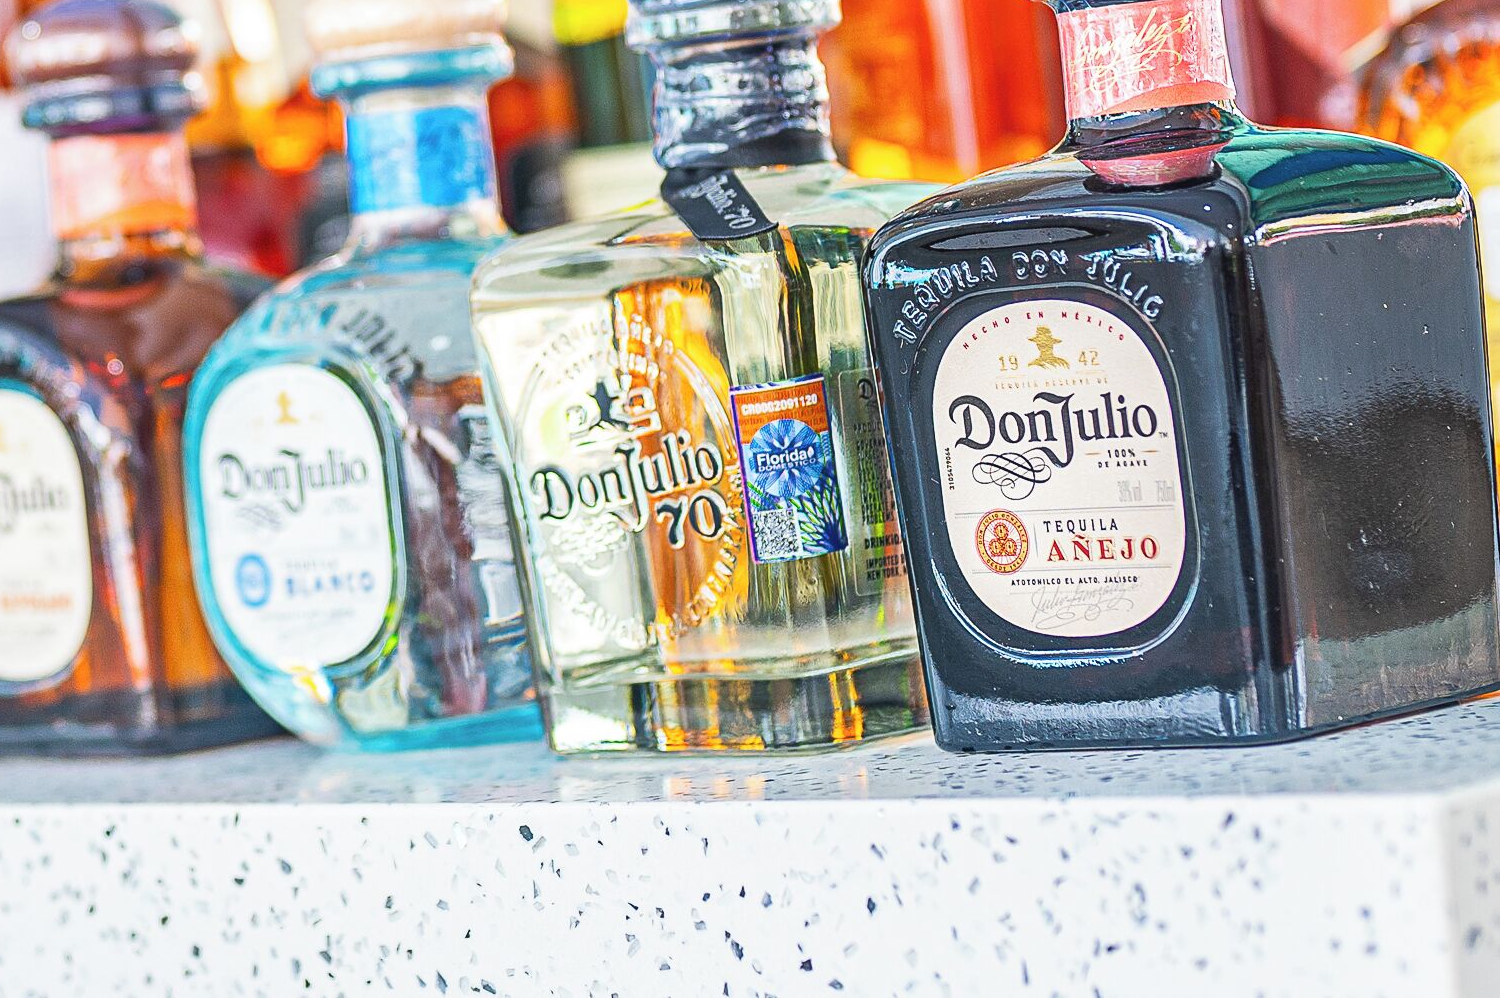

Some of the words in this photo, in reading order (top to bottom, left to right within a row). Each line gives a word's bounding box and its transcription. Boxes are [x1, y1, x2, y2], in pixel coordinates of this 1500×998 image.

[893, 256, 998, 344] TEQUILA
[1012, 249, 1069, 281] DON
[963, 316, 1011, 350] HECHO
[1026, 312, 1045, 321] EN
[1061, 311, 1125, 342] MÉXICO
[757, 448, 806, 466] Florida
[1107, 448, 1136, 459] 100%
[758, 458, 816, 472] DOMESTICO
[1098, 461, 1110, 469] DE
[1116, 459, 1149, 468] AGAVE
[655, 492, 726, 549] 70
[1043, 518, 1119, 535] TEQUILA
[1046, 534, 1159, 562] AÑEJO
[1011, 577, 1062, 587] ATOTONILCO
[1065, 576, 1075, 585] EL
[1104, 574, 1139, 584] JALISCO
